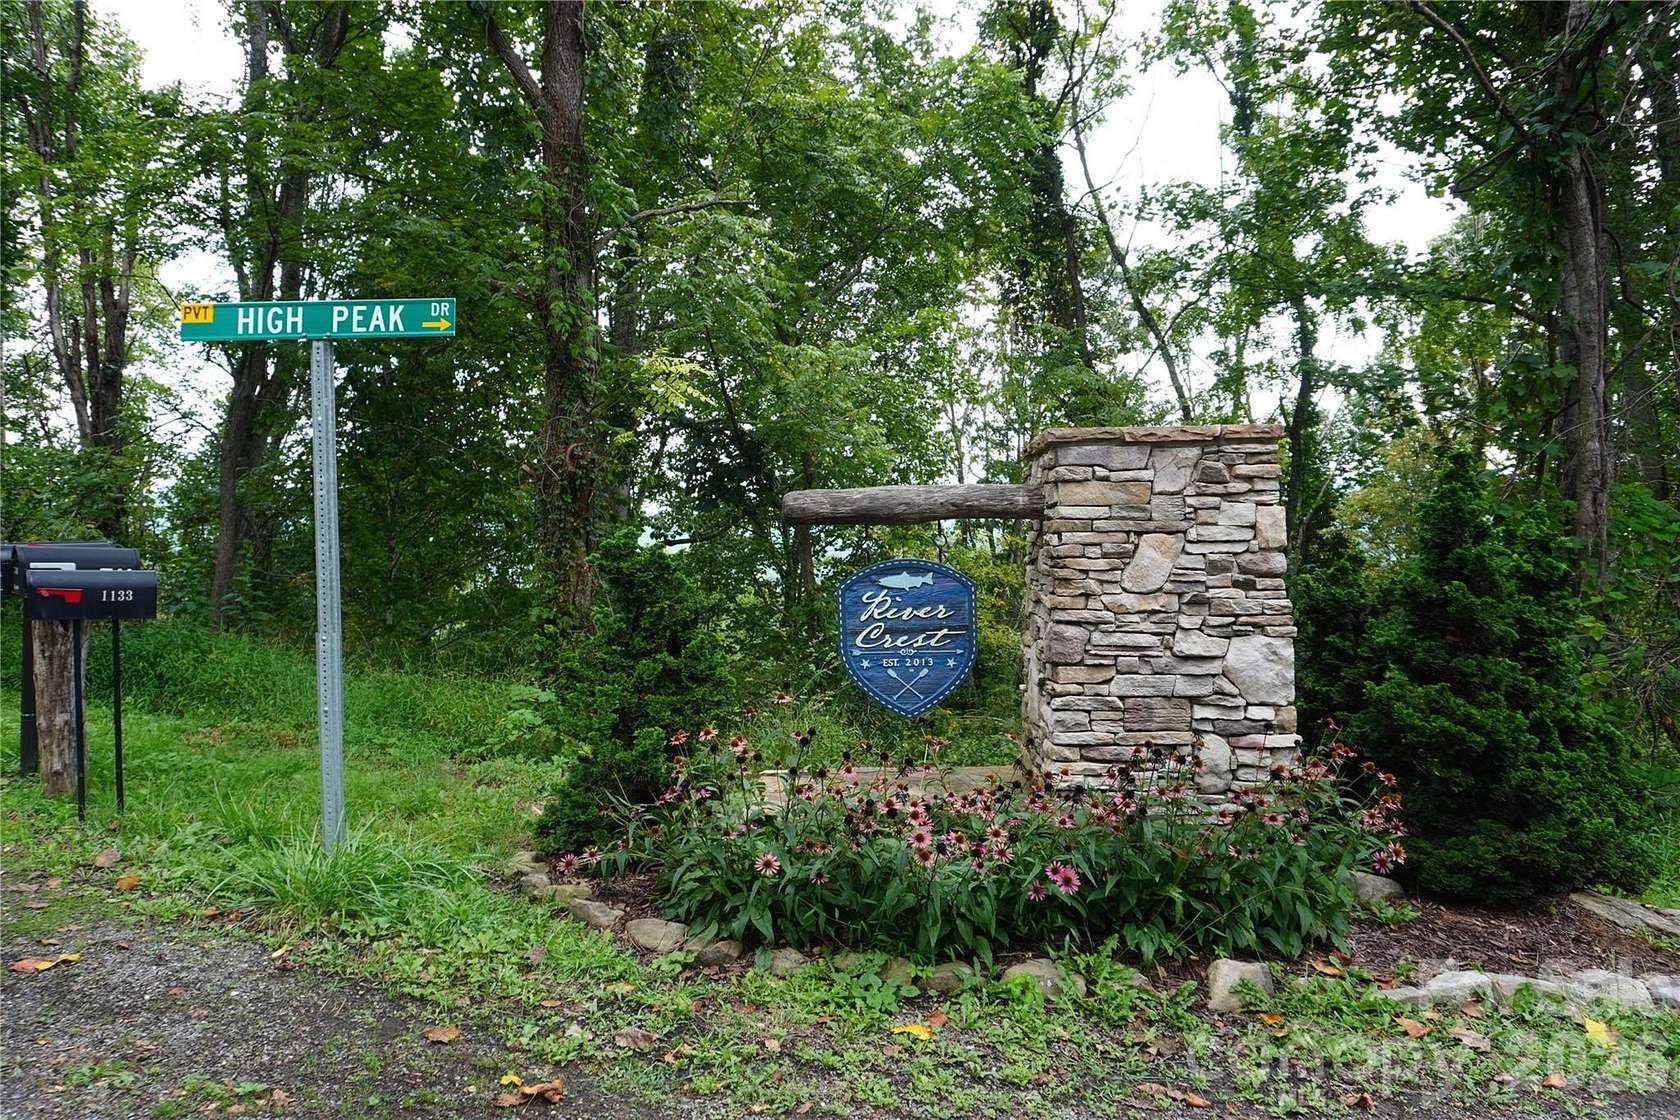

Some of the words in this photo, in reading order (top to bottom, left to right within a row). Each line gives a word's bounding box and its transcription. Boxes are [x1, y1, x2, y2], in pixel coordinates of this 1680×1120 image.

[182, 306, 211, 321] PVT
[238, 306, 304, 334] HIGH
[333, 303, 405, 332] PEAK
[431, 303, 449, 316] DR
[102, 589, 134, 602] 1133
[861, 589, 955, 622] River
[856, 623, 966, 648] Crest
[883, 659, 900, 667] EST.
[906, 658, 934, 667] 2013
